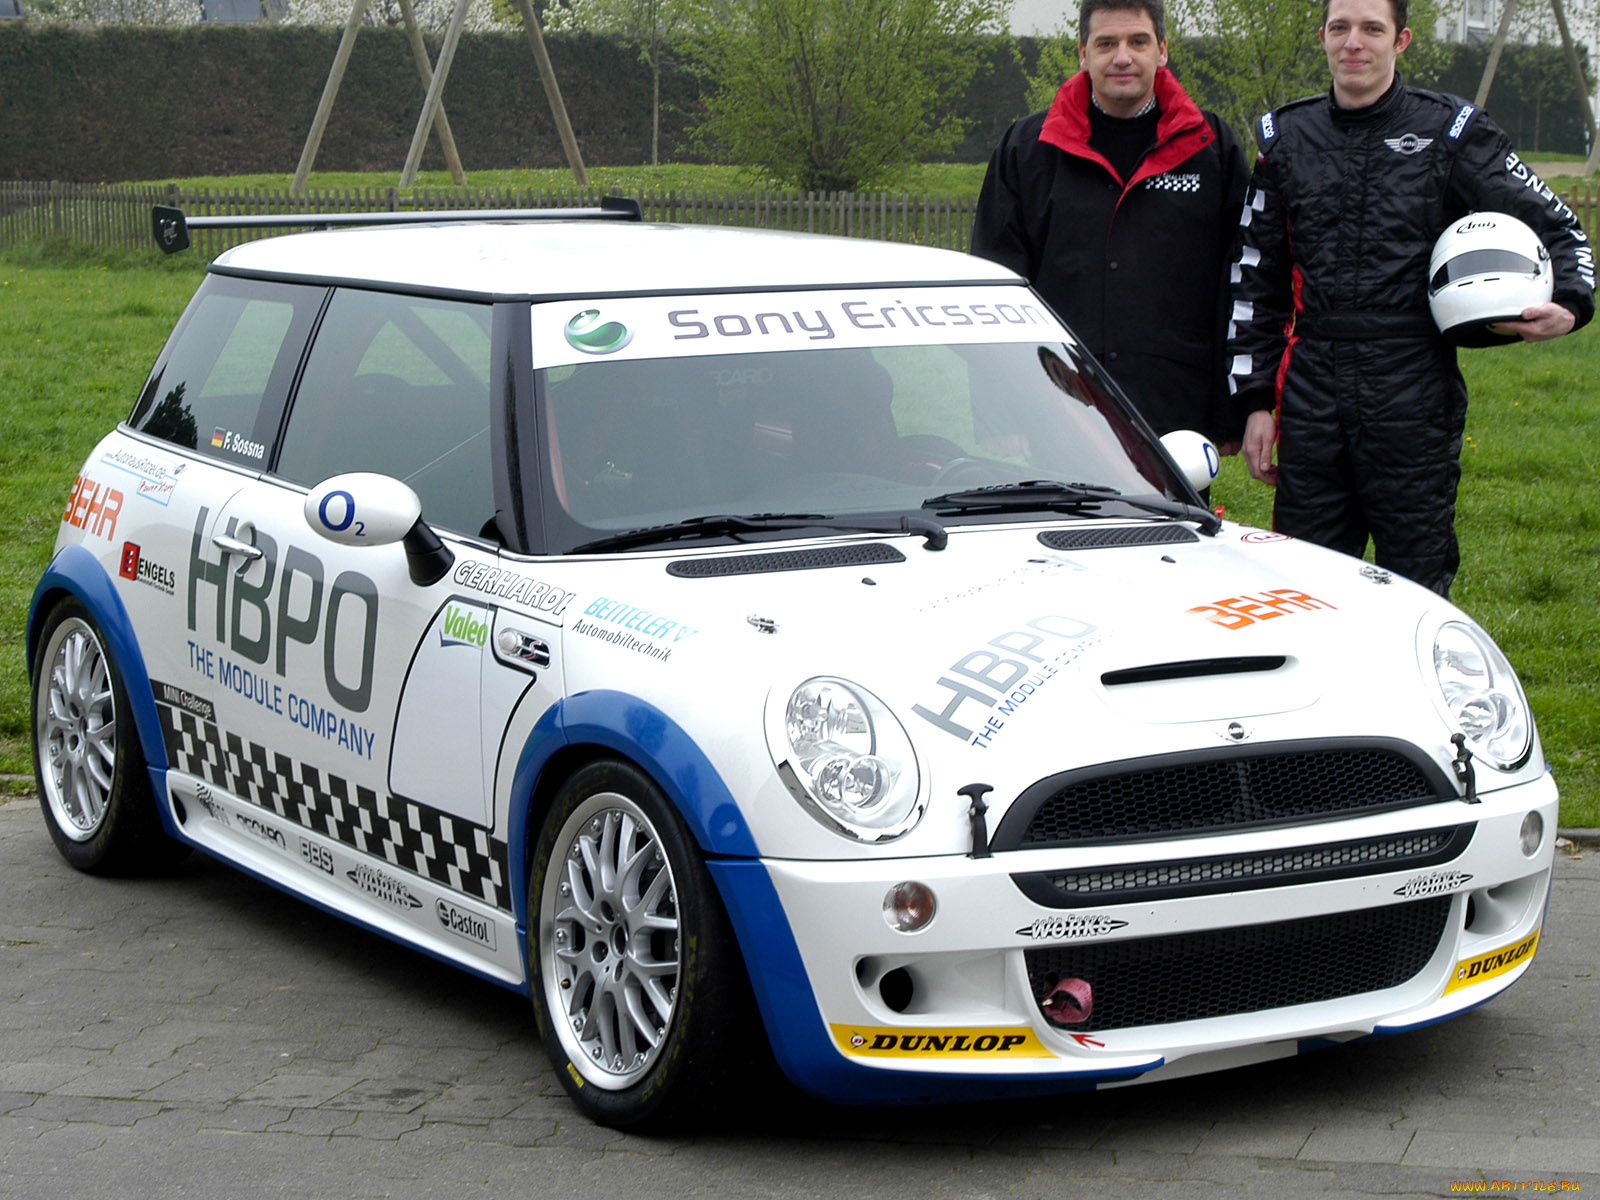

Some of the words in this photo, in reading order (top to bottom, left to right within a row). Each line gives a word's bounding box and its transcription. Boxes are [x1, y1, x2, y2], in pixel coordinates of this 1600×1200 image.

[668, 309, 835, 341] Sony
[841, 300, 1050, 330] Ericsson
[223, 431, 233, 450] F.
[232, 433, 265, 460] Sossna
[63, 474, 124, 542] BEHR
[138, 558, 175, 588] ENGELS
[453, 560, 577, 616] GERHARDI
[187, 505, 379, 713] HBPO
[444, 604, 488, 647] Valeo
[584, 597, 677, 640] BENTELER
[1184, 588, 1338, 631] BEHR
[572, 618, 673, 662] Automobiltechnik
[911, 615, 1098, 741] HBPO
[180, 690, 213, 720] Challenge
[187, 640, 214, 679] THE
[219, 657, 283, 716] MODULE
[288, 693, 375, 760] COMPANY
[971, 716, 1005, 748] THE
[998, 665, 1059, 716] MODULE
[450, 907, 489, 943] Castrol
[1031, 917, 1112, 940] WORKS
[1467, 936, 1537, 979] DUNLOP
[869, 1034, 1026, 1051] DUNLOP
